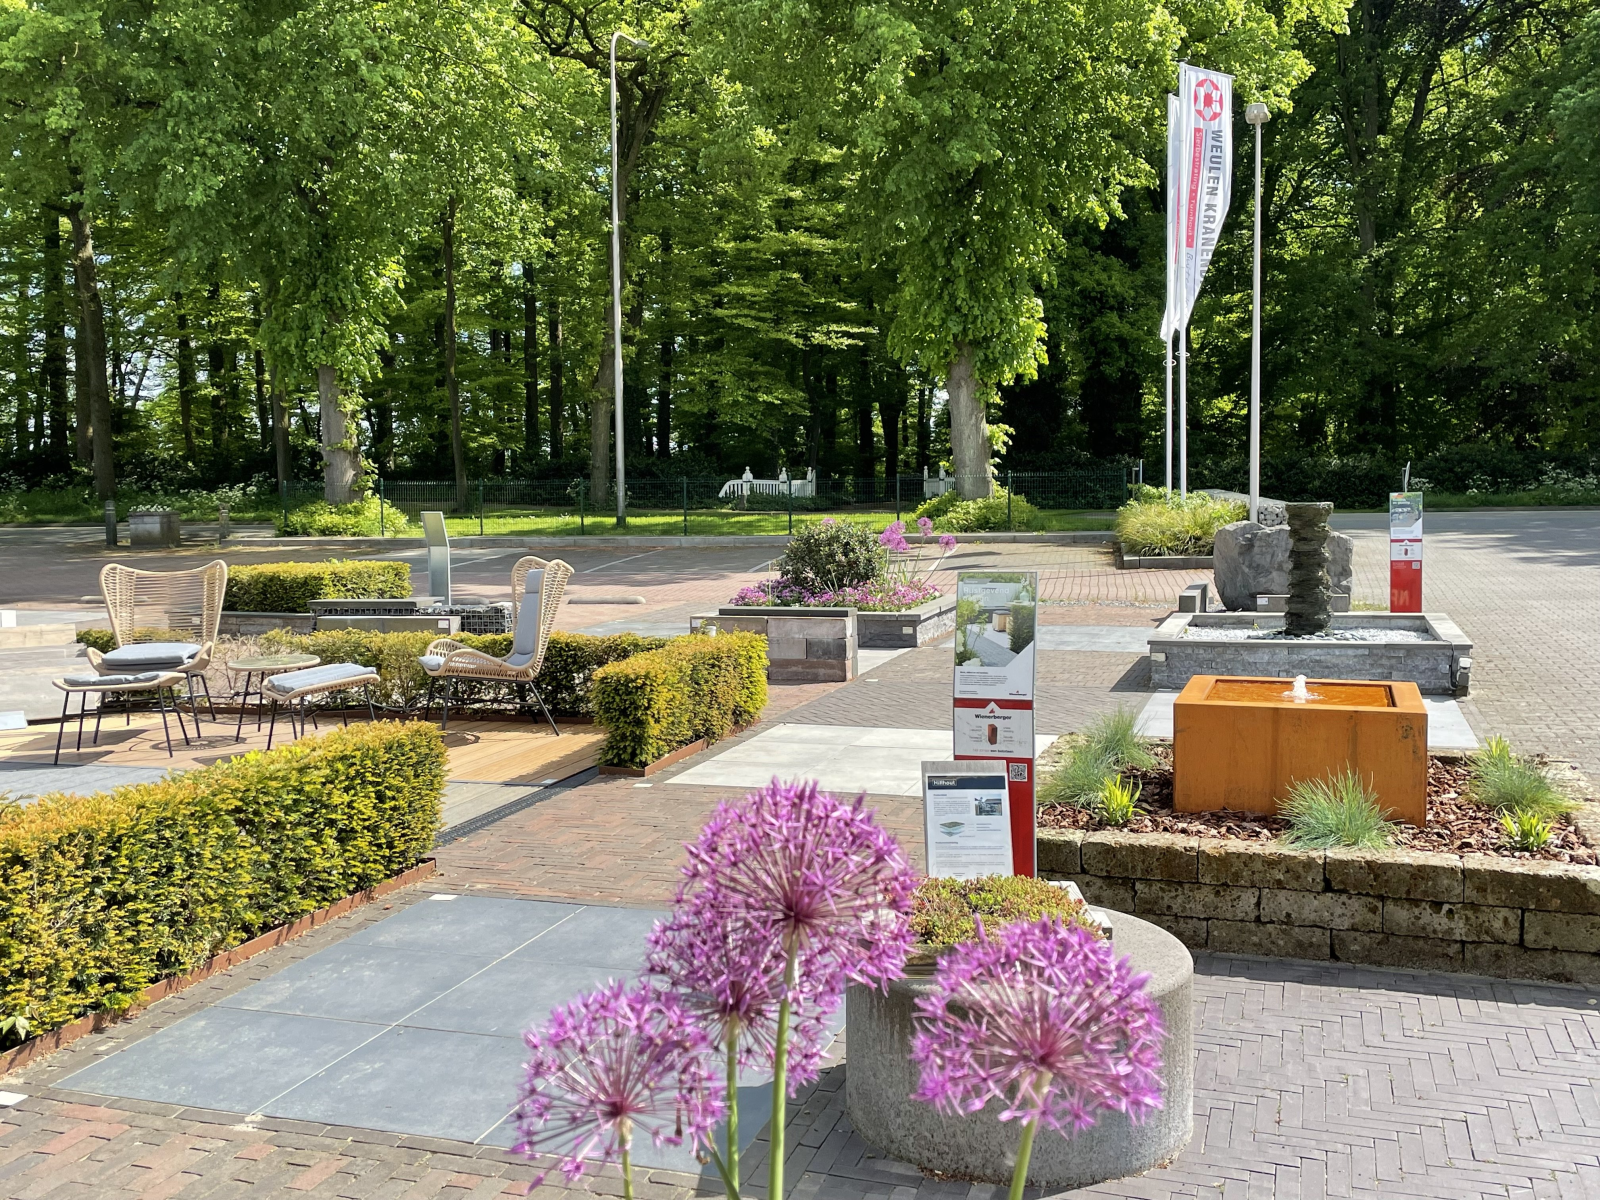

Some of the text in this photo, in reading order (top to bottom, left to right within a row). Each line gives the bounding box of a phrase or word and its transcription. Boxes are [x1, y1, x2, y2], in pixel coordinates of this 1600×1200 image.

[1191, 131, 1202, 190] Sierbestrating
[1206, 129, 1223, 196] WEULEN
[963, 587, 1010, 595] Rustgevend
[974, 713, 1012, 721] Wienerberger
